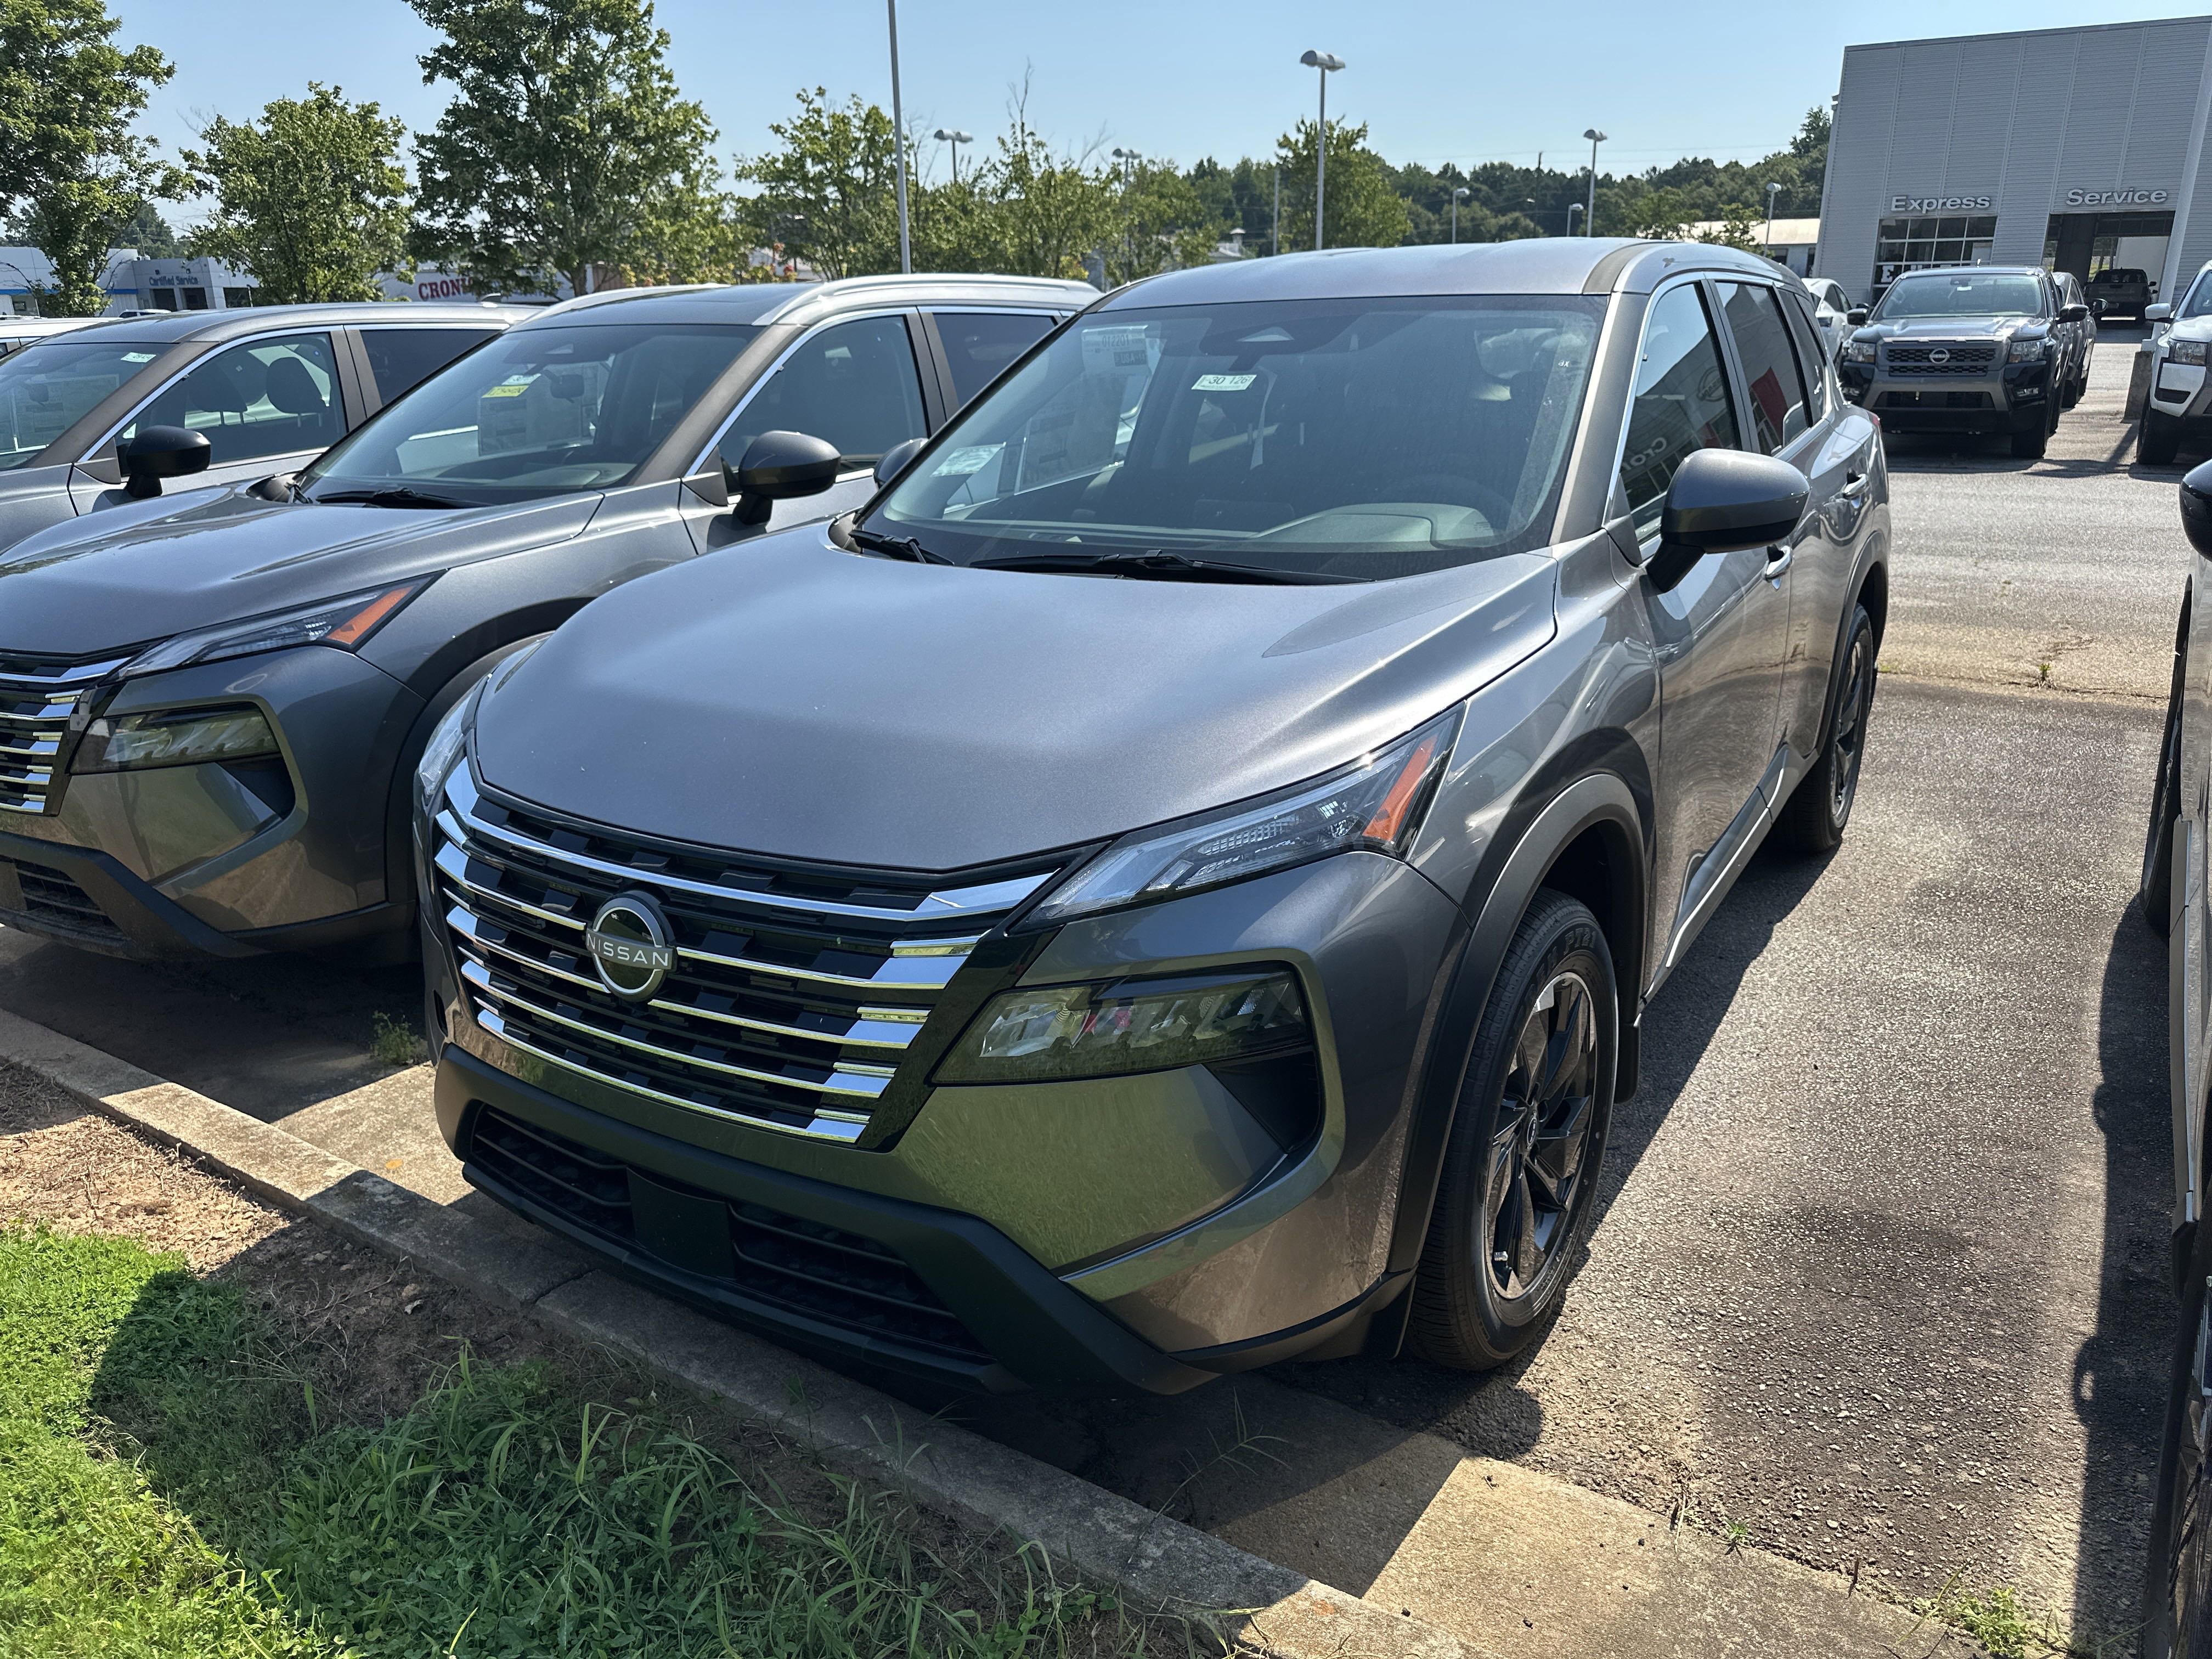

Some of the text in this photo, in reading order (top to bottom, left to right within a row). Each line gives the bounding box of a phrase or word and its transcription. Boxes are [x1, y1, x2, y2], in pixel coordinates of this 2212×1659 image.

[1891, 188, 2168, 214] Express Service
[1209, 376, 1226, 385] 30
[586, 933, 668, 967] NISSAN
